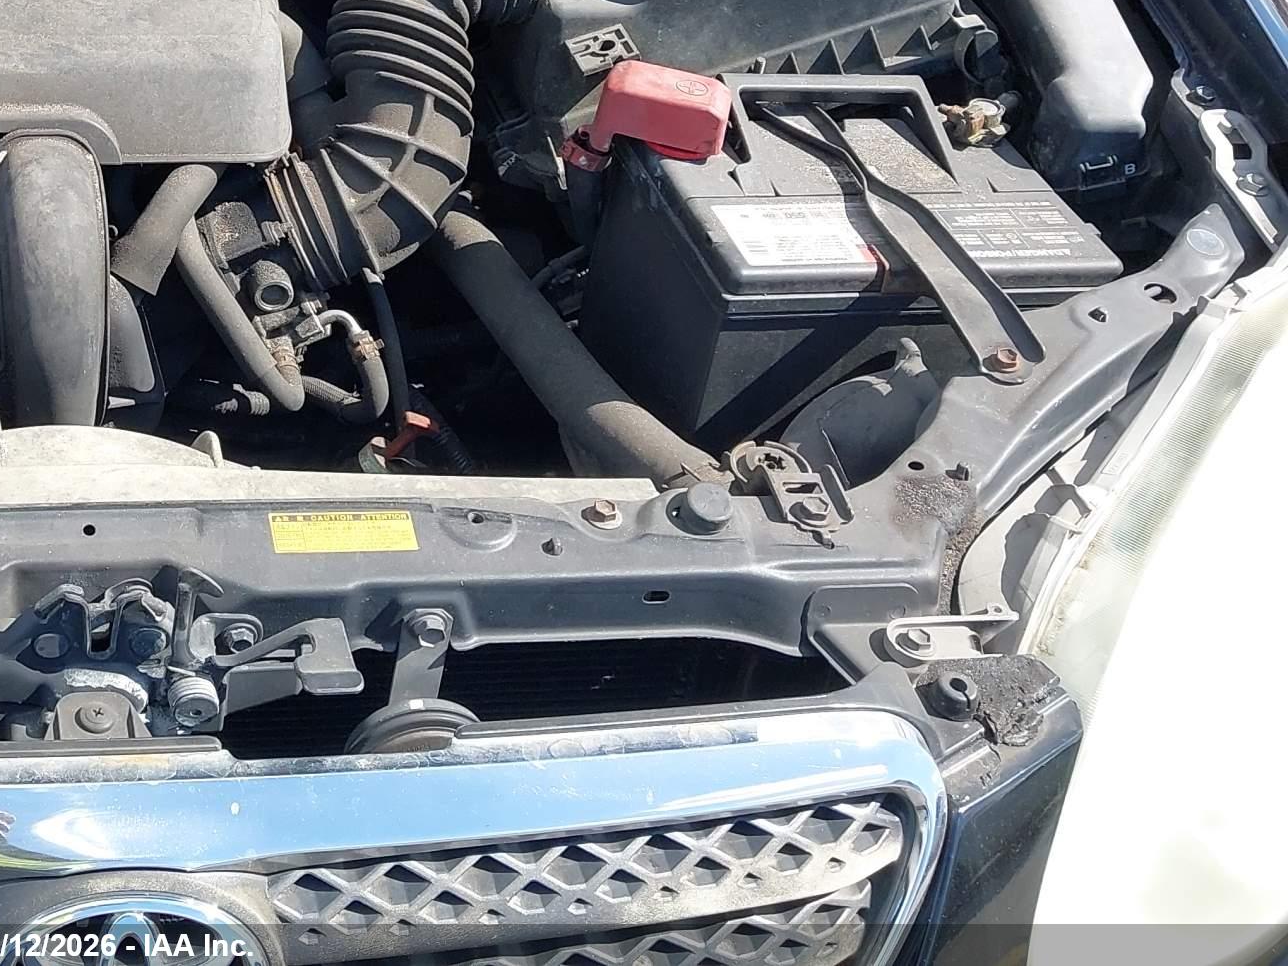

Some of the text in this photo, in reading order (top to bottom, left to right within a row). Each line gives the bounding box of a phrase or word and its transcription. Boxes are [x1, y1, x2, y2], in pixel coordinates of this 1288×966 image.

[1124, 163, 1136, 175] B
[311, 514, 354, 522] CAUTION
[361, 513, 408, 521] ATTENTION
